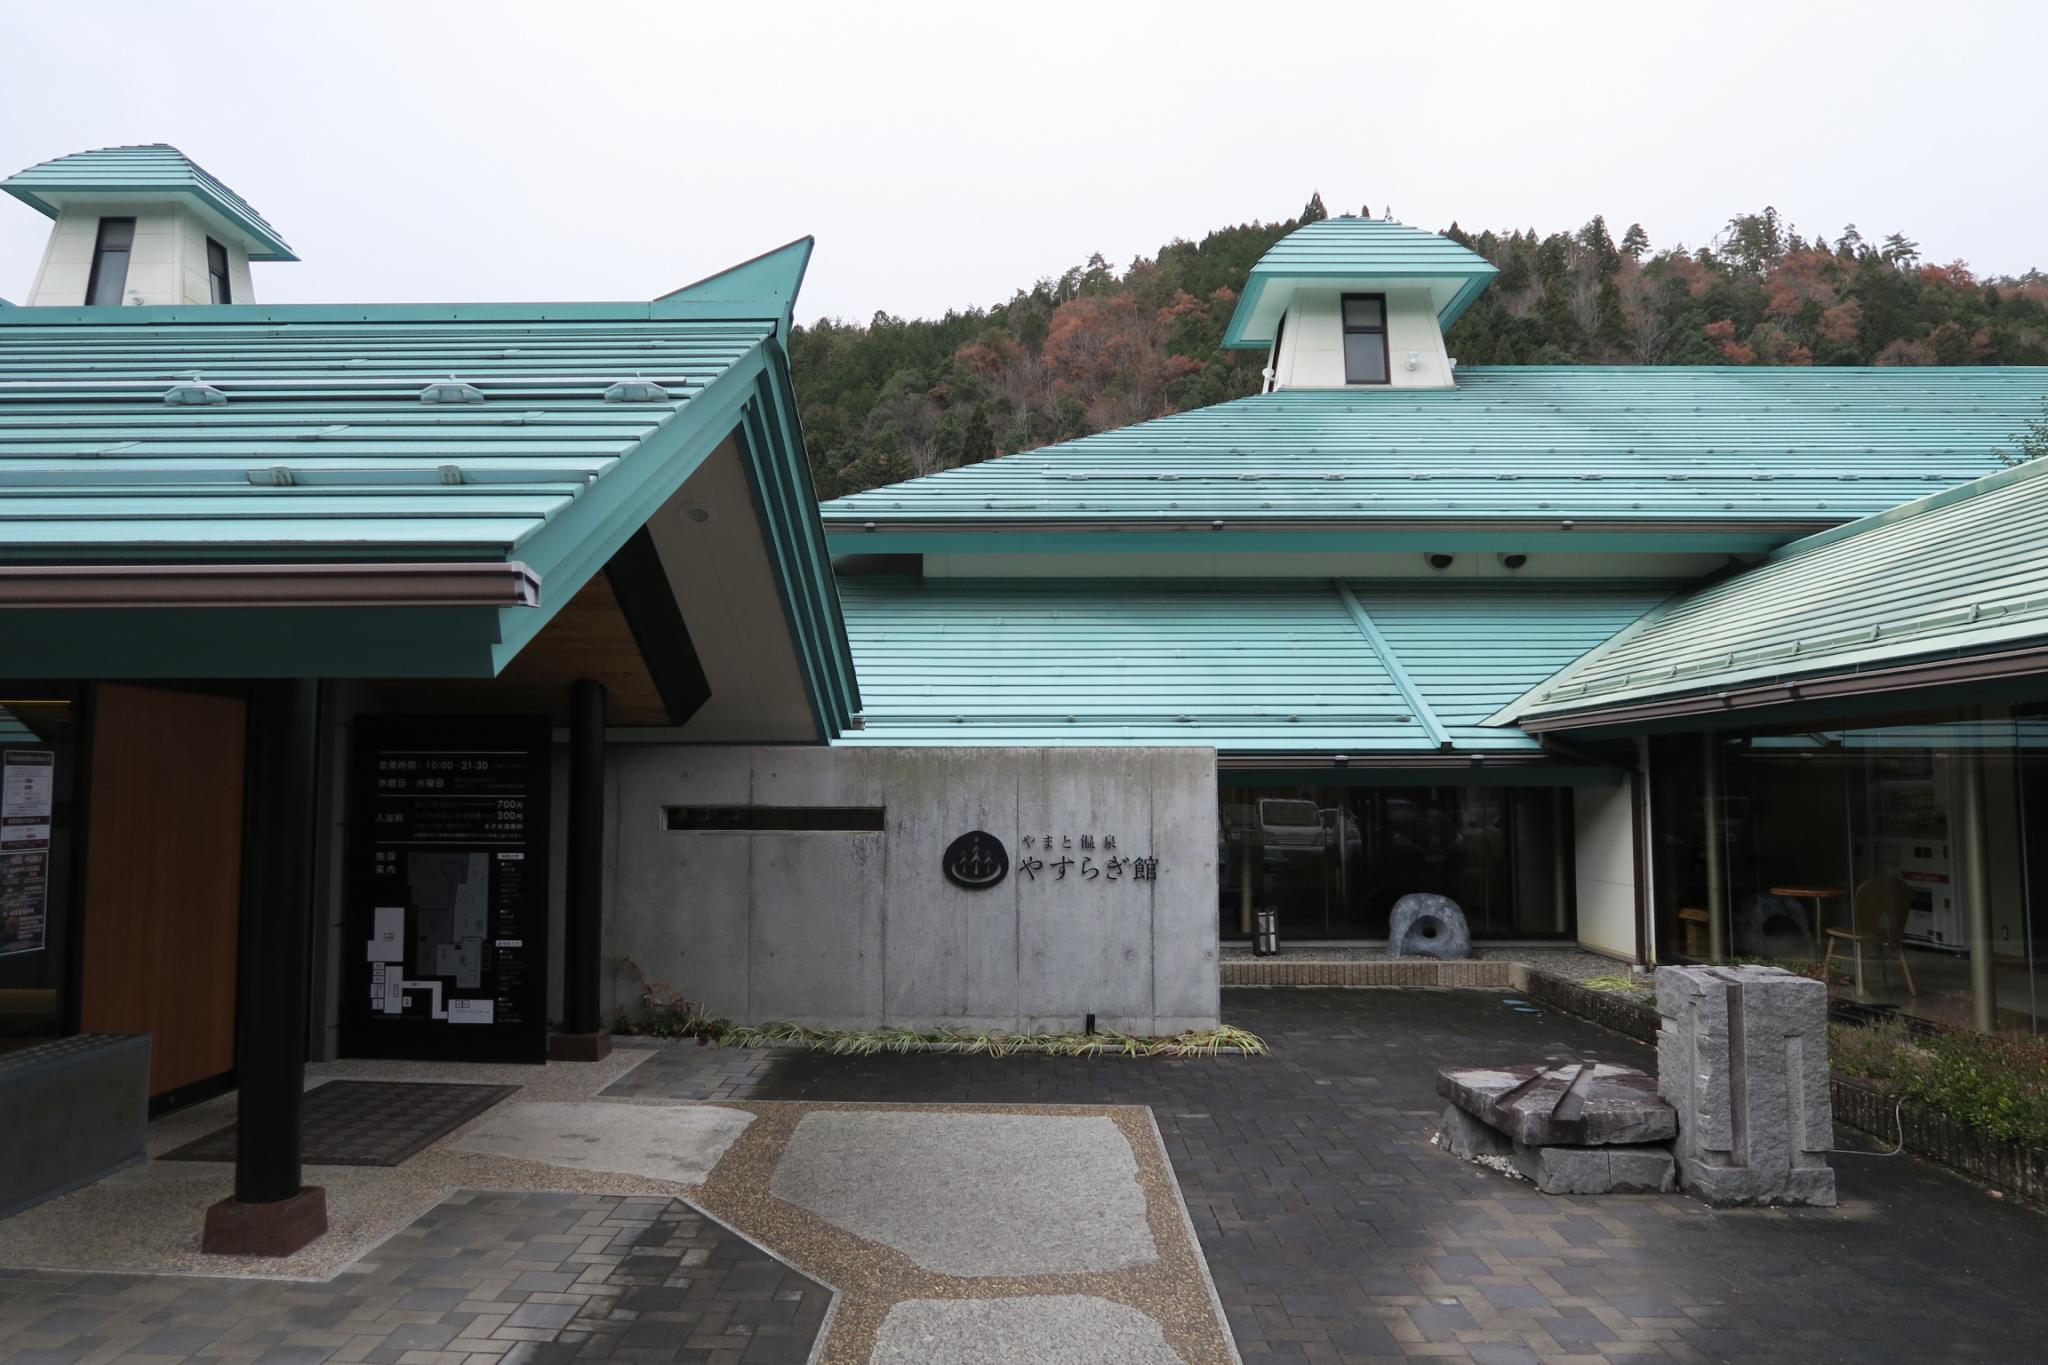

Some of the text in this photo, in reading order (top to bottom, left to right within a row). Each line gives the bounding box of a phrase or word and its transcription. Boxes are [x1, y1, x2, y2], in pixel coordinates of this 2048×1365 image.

[1022, 834, 1117, 849] やまと温泉
[1019, 855, 1159, 881] やすらぎ館
